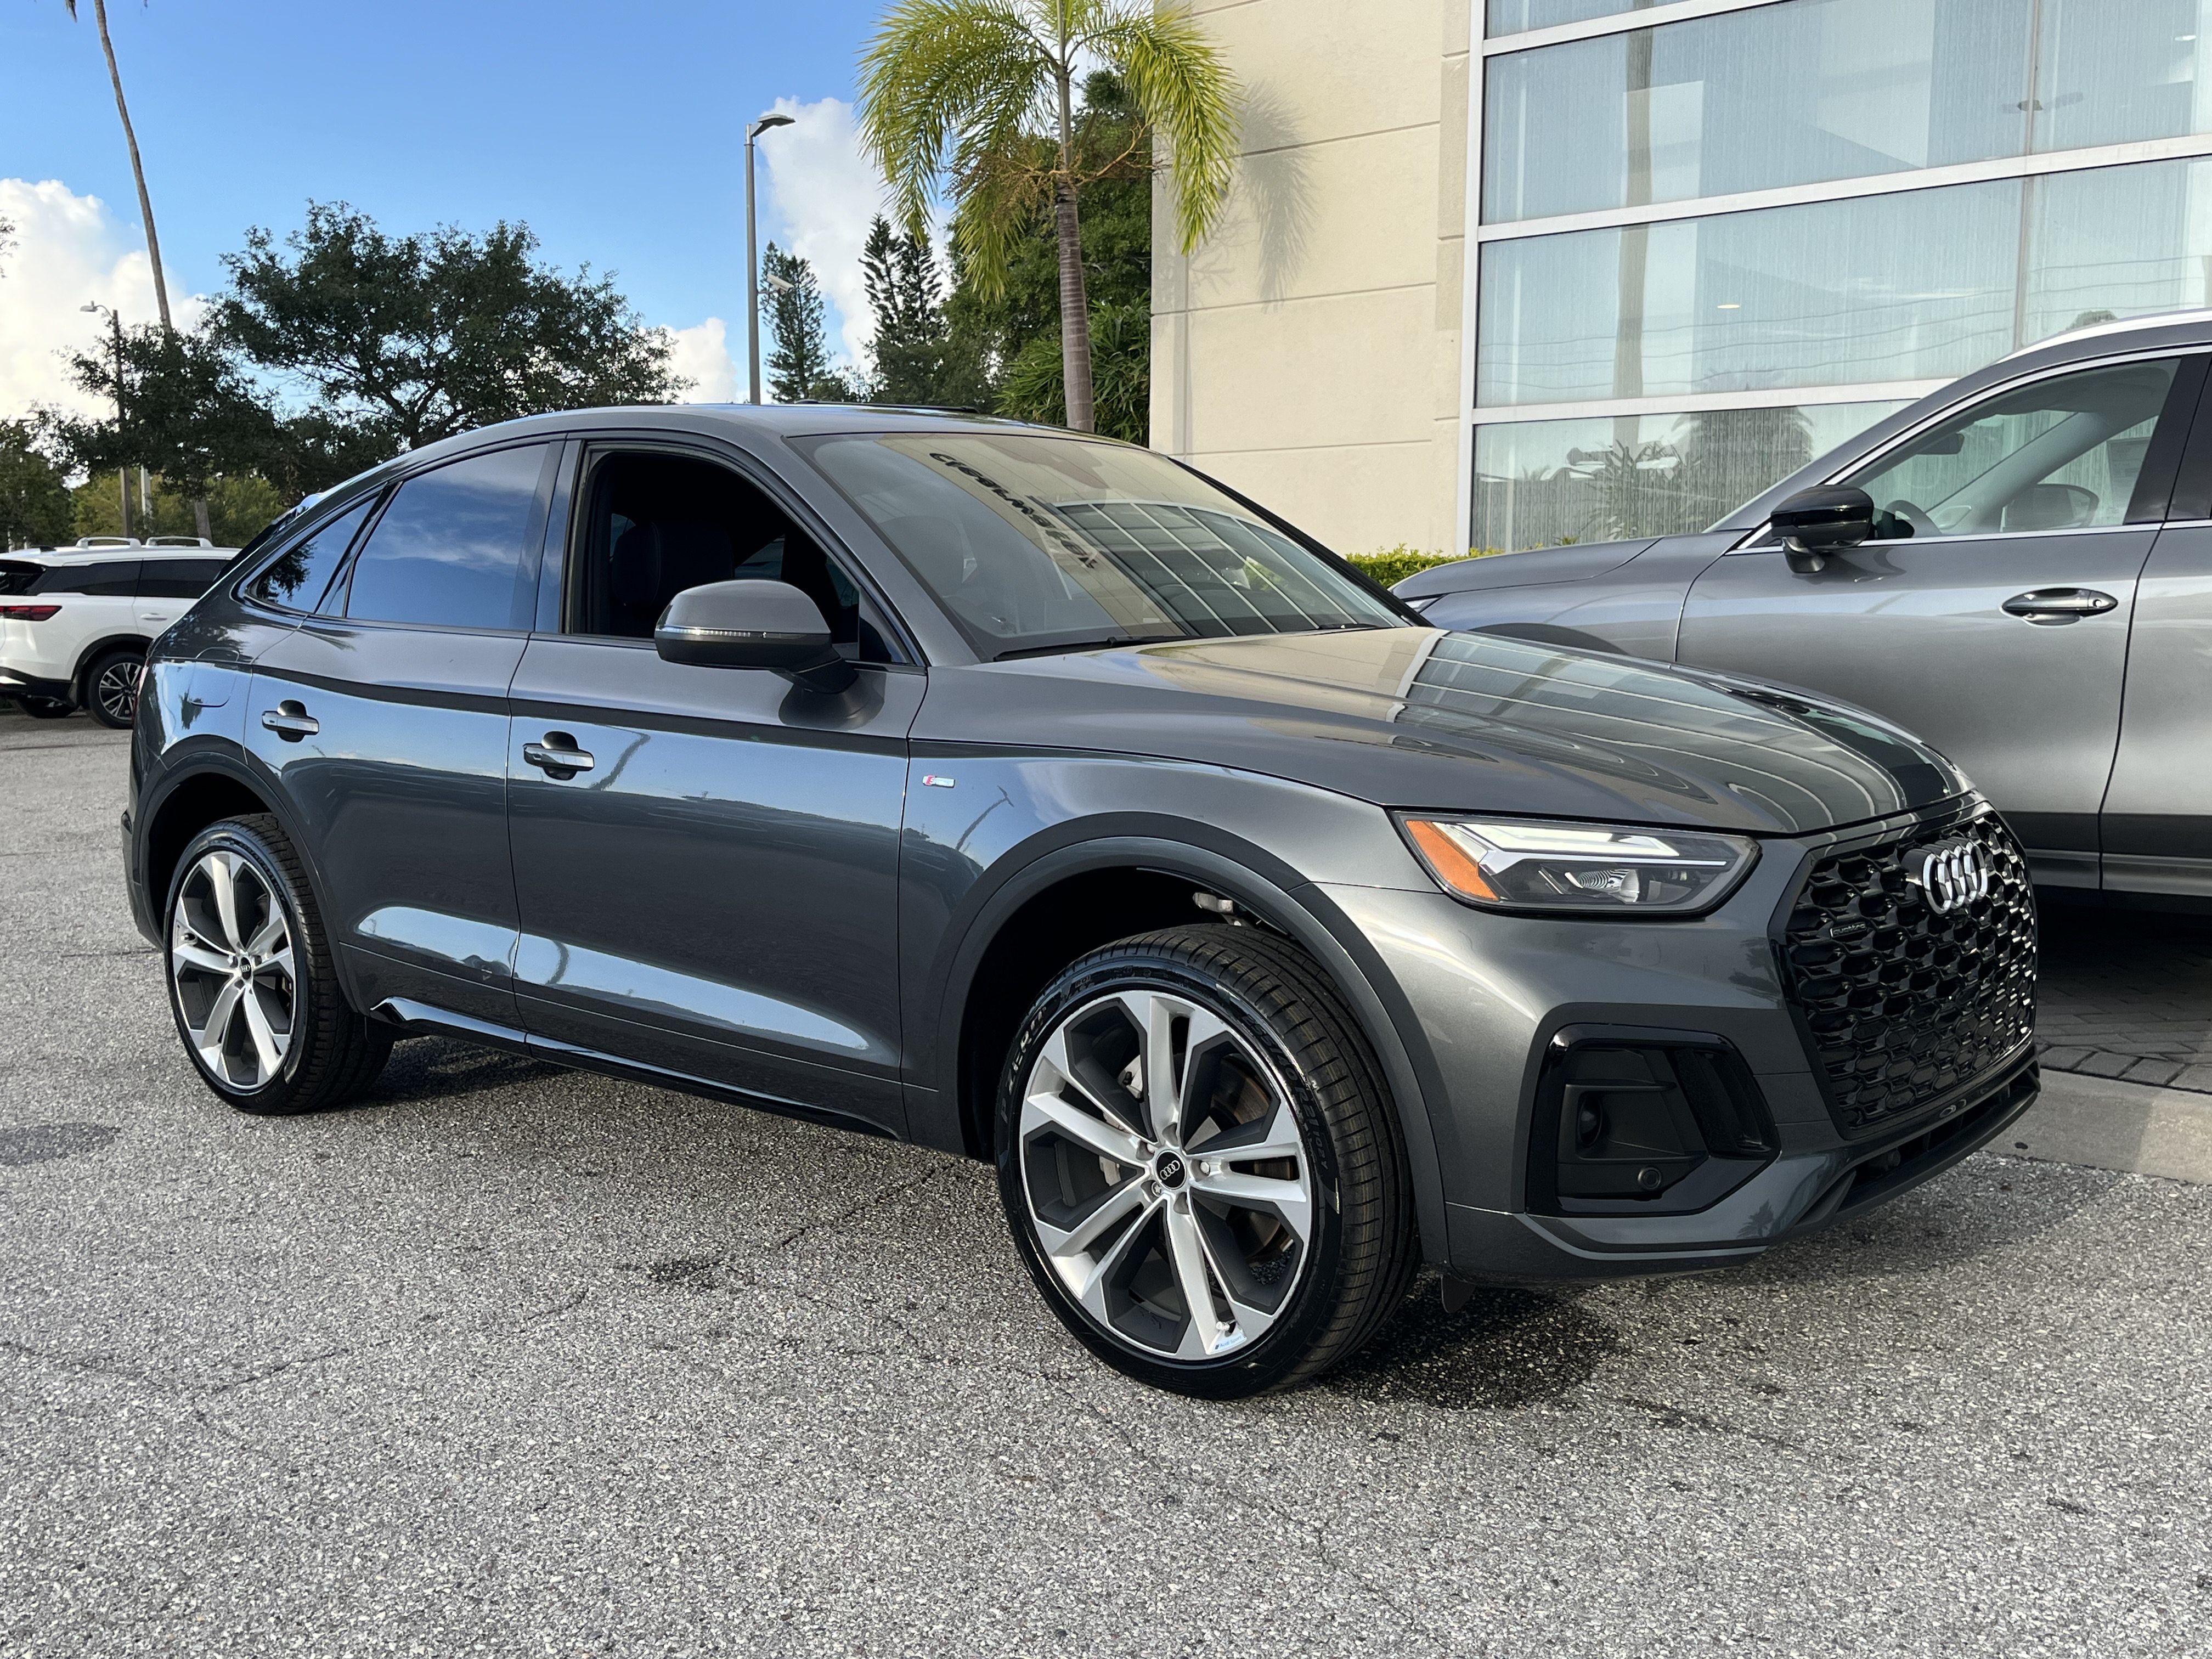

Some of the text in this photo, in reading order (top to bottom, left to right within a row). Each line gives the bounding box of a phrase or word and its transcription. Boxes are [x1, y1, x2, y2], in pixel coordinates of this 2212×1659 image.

[1833, 923, 1866, 935] quattro
[1243, 1015, 1298, 1081] 255/40
[1295, 1086, 1319, 1126] R21
[1001, 1098, 1008, 1124] P
